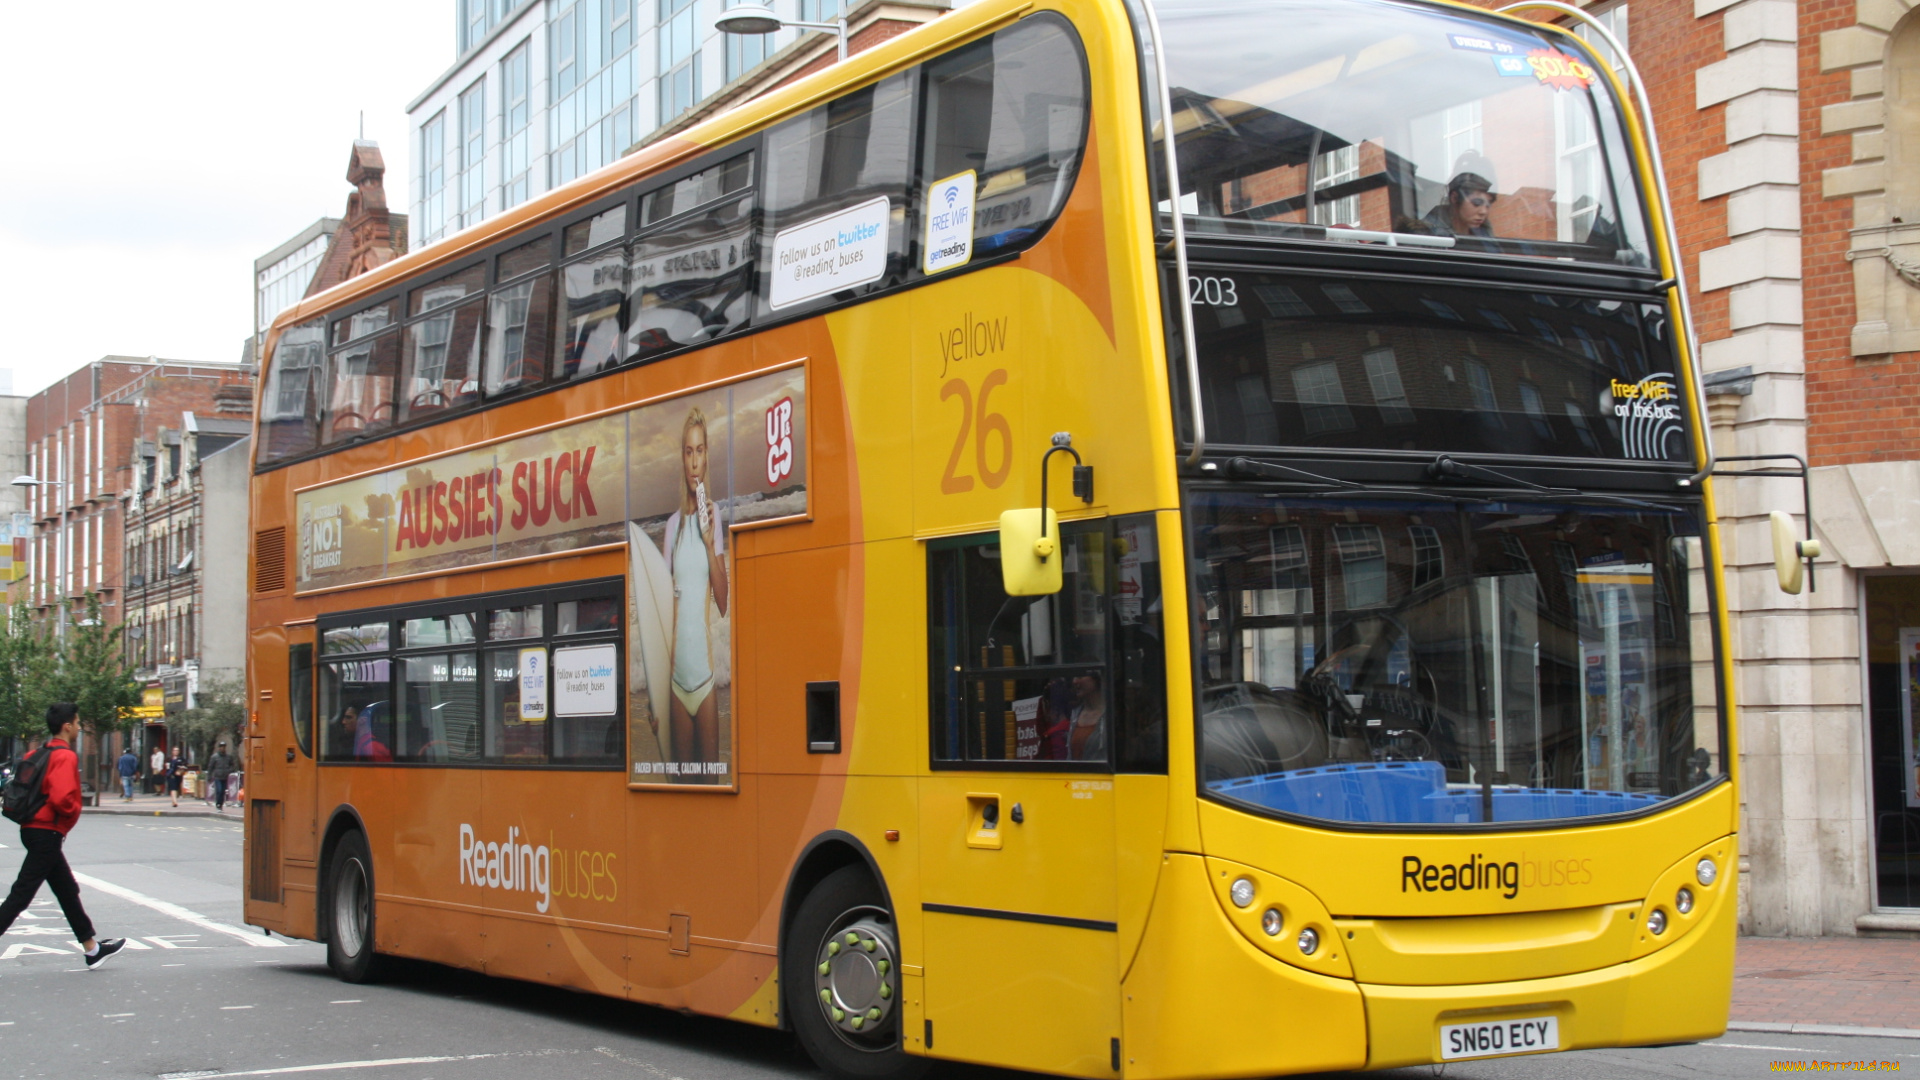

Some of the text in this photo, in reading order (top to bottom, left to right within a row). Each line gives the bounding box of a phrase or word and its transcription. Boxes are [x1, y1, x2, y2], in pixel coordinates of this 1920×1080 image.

[1454, 36, 1513, 54] UNDER 19?
[1500, 58, 1523, 71] GO
[932, 206, 968, 232] FREE WiFi
[779, 222, 880, 271] follow us on twitter
[794, 249, 863, 281] @reading_buses
[1188, 276, 1238, 306] 203
[940, 311, 1007, 378] yellow
[1611, 378, 1670, 400] free WiFi
[1614, 402, 1674, 419] on this bus
[940, 368, 1013, 495] 26
[396, 467, 503, 551] AUSSIES
[510, 445, 598, 530] SUCK
[313, 518, 342, 553] NO.1
[313, 550, 342, 570] BREAKFAST
[494, 668, 513, 678] oad
[557, 665, 612, 682] follow us on twitter
[566, 681, 605, 695] @reading_buses
[634, 762, 651, 774] PACKED
[652, 762, 664, 774] WITH
[681, 762, 701, 774] CALCIUM
[702, 762, 707, 774] &
[707, 762, 727, 774] PROTEIN
[1450, 1021, 1548, 1053] SN60 ECY
